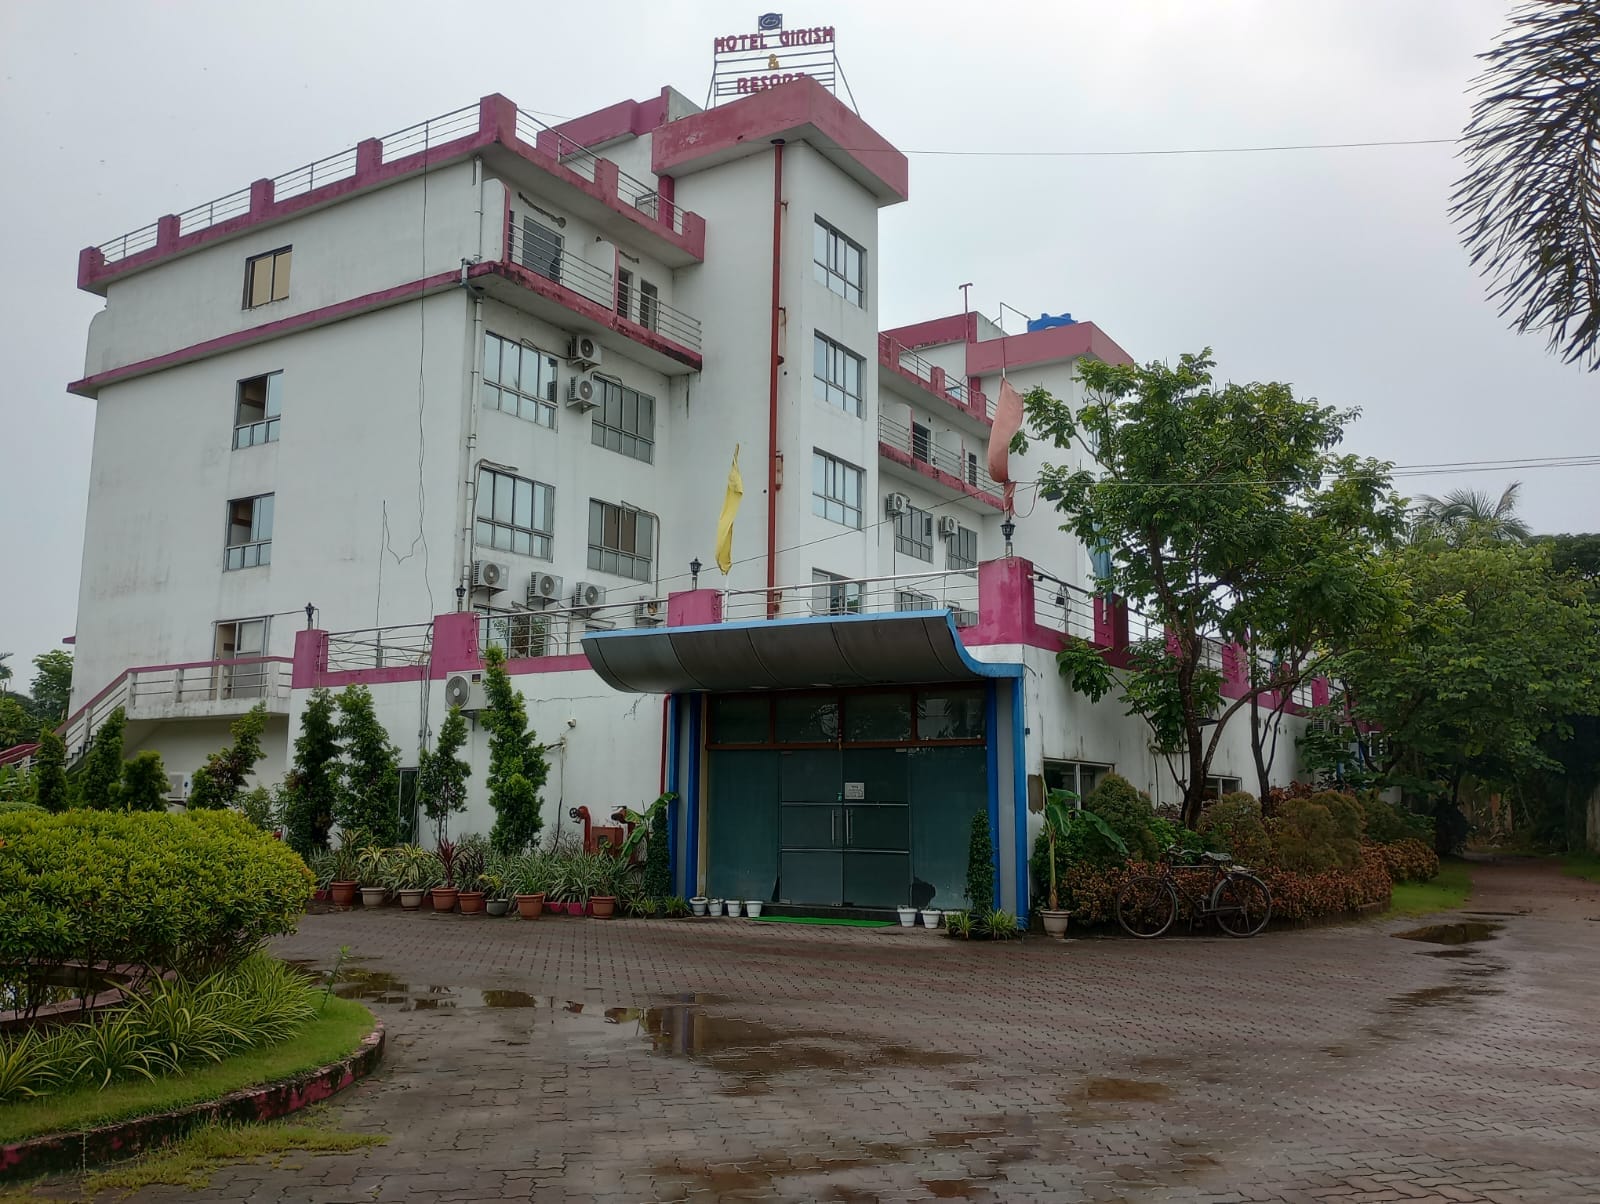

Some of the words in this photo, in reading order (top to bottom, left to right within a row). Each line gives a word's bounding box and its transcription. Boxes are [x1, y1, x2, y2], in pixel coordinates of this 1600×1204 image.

[714, 33, 767, 53] HOTEL
[780, 26, 834, 47] GIRISH
[768, 53, 779, 69] &
